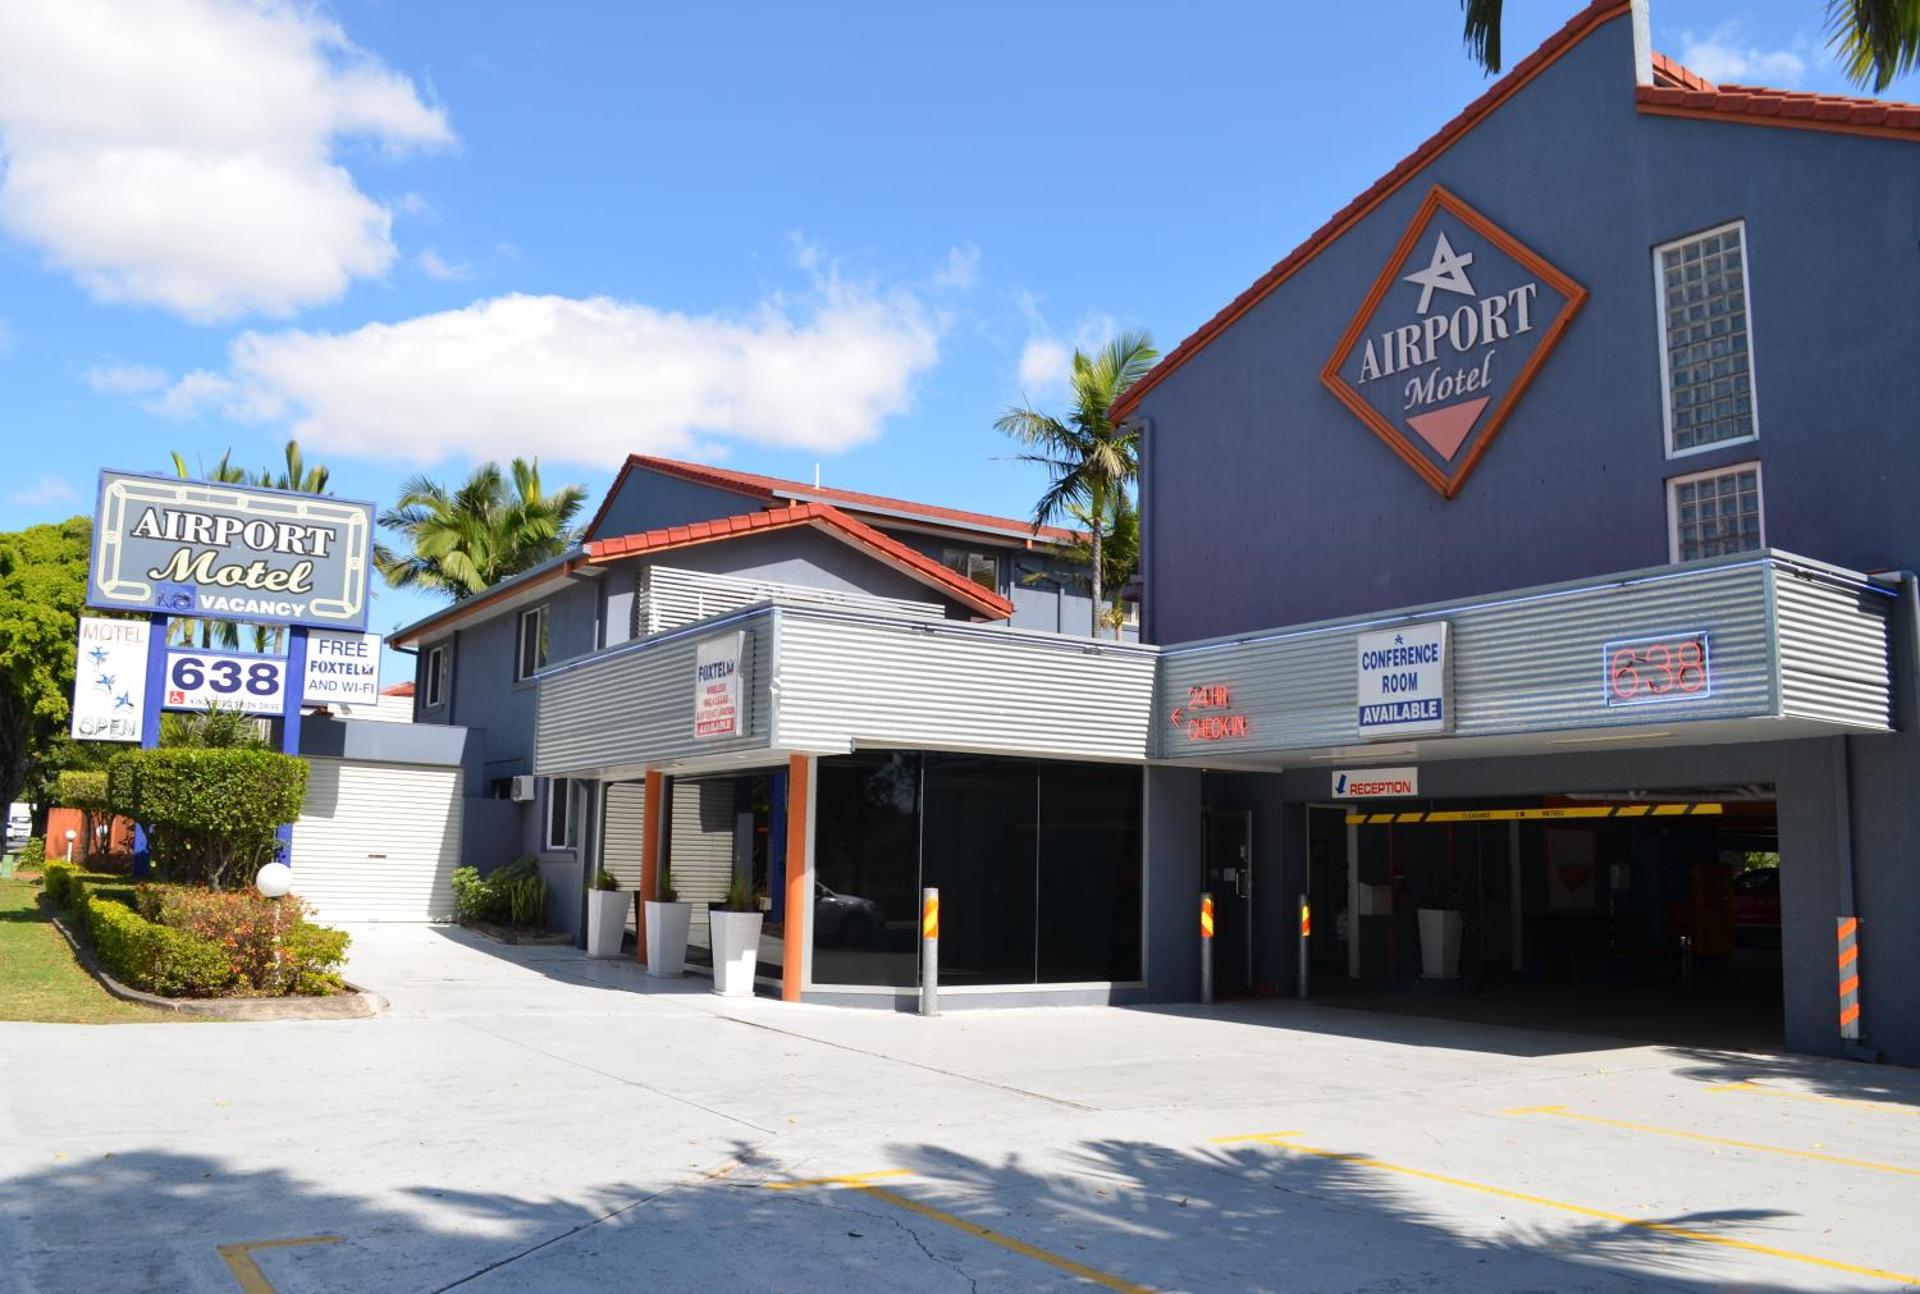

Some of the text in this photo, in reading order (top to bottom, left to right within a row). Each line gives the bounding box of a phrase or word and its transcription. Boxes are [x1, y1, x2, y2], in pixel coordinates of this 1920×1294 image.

[1357, 283, 1536, 384] AIRPORT
[1403, 350, 1495, 410] Motel
[132, 507, 335, 558] AIRPORT
[148, 548, 313, 593] Motel
[200, 595, 305, 618] VACANCY
[83, 624, 144, 643] MOTEL
[319, 639, 369, 658] FREE
[1362, 644, 1438, 670] CONFERENCE
[171, 657, 280, 696] 638
[310, 660, 360, 675] FOXTEL
[698, 660, 727, 682] FOXTEL
[1611, 641, 1705, 698] 638
[309, 679, 374, 694] AND WI-FI
[1382, 673, 1418, 693] ROOM
[1363, 700, 1437, 724] AVAILABLE
[79, 716, 136, 738] OPEN
[1350, 781, 1411, 796] RECEPTION
